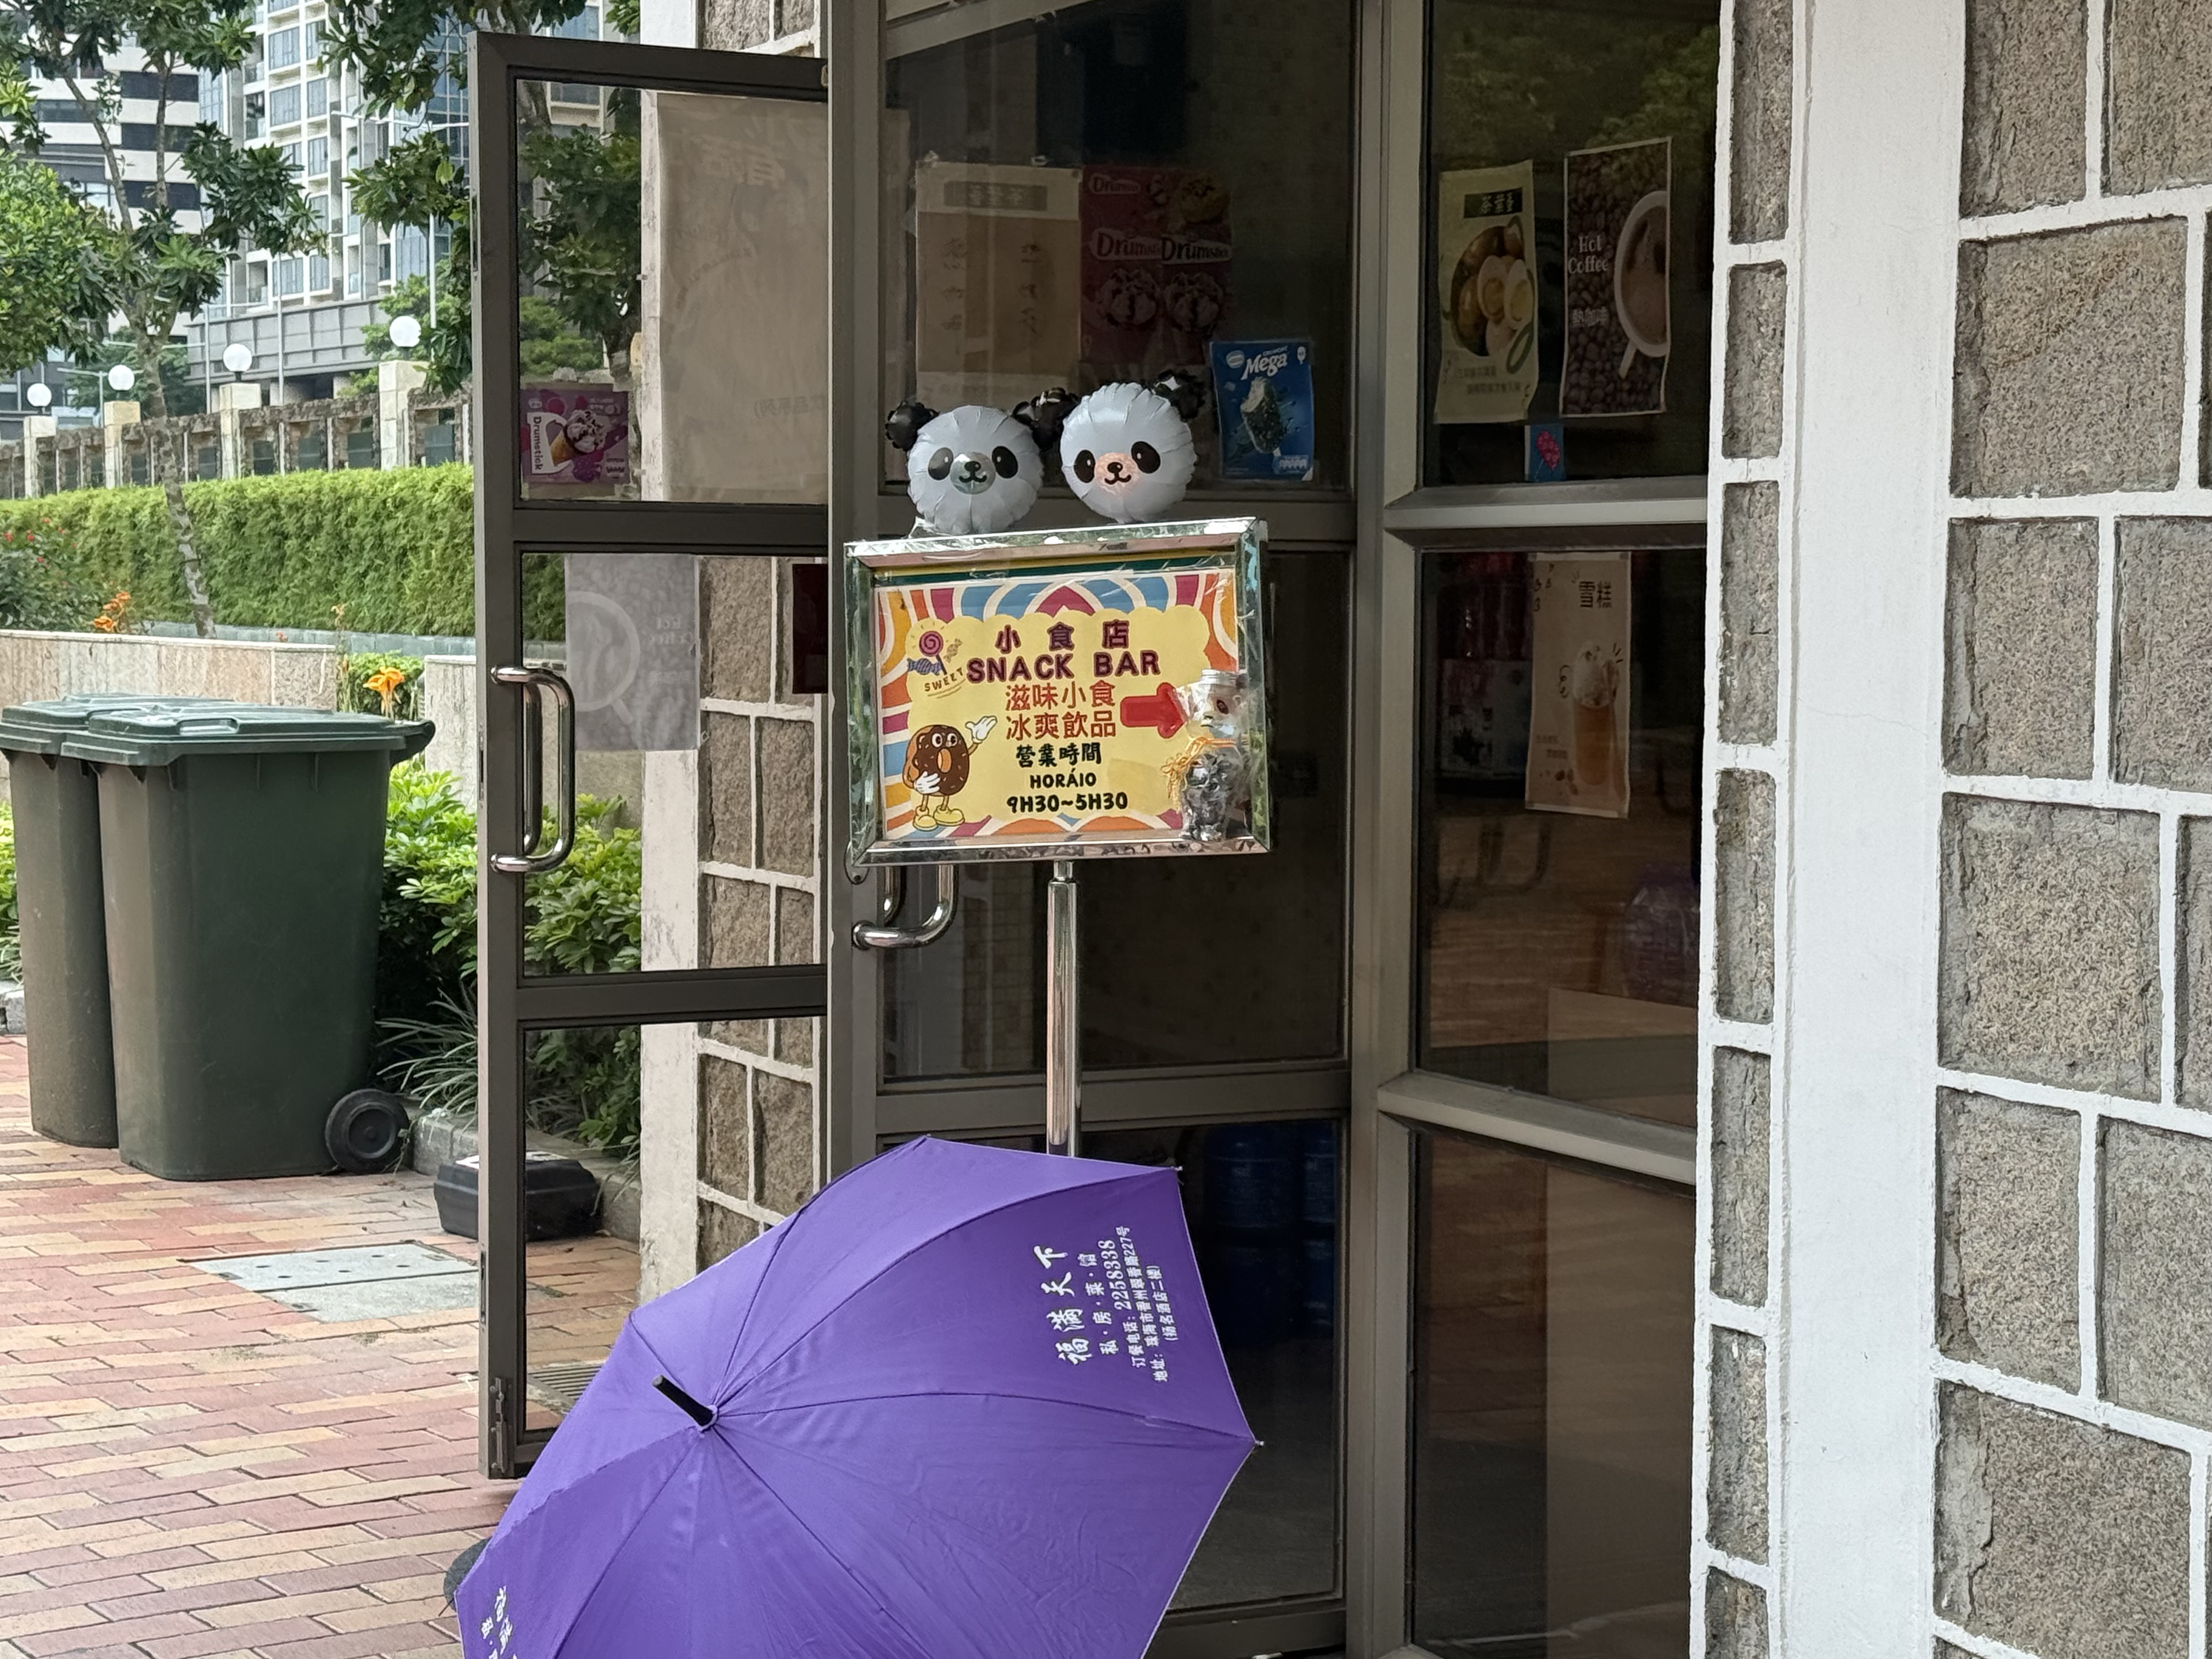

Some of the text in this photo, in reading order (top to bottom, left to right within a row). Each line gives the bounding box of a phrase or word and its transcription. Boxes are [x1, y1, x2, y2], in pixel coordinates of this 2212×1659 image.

[1578, 235, 1602, 253] Hot
[1568, 255, 1609, 274] Coffee
[1240, 353, 1288, 380] Mega
[533, 416, 543, 471] Drumstick
[1579, 581, 1612, 608] 雪糕
[995, 619, 1130, 653] 小食店
[924, 668, 963, 691] SWEET
[967, 651, 1160, 684] SNACK BAR
[1006, 680, 1116, 712] 滋味小食
[1006, 710, 1116, 741] 冰爽飲品
[1015, 742, 1102, 767] 營業時間
[1030, 769, 1097, 789] HORÁIO
[1098, 1240, 1132, 1310] 2258338
